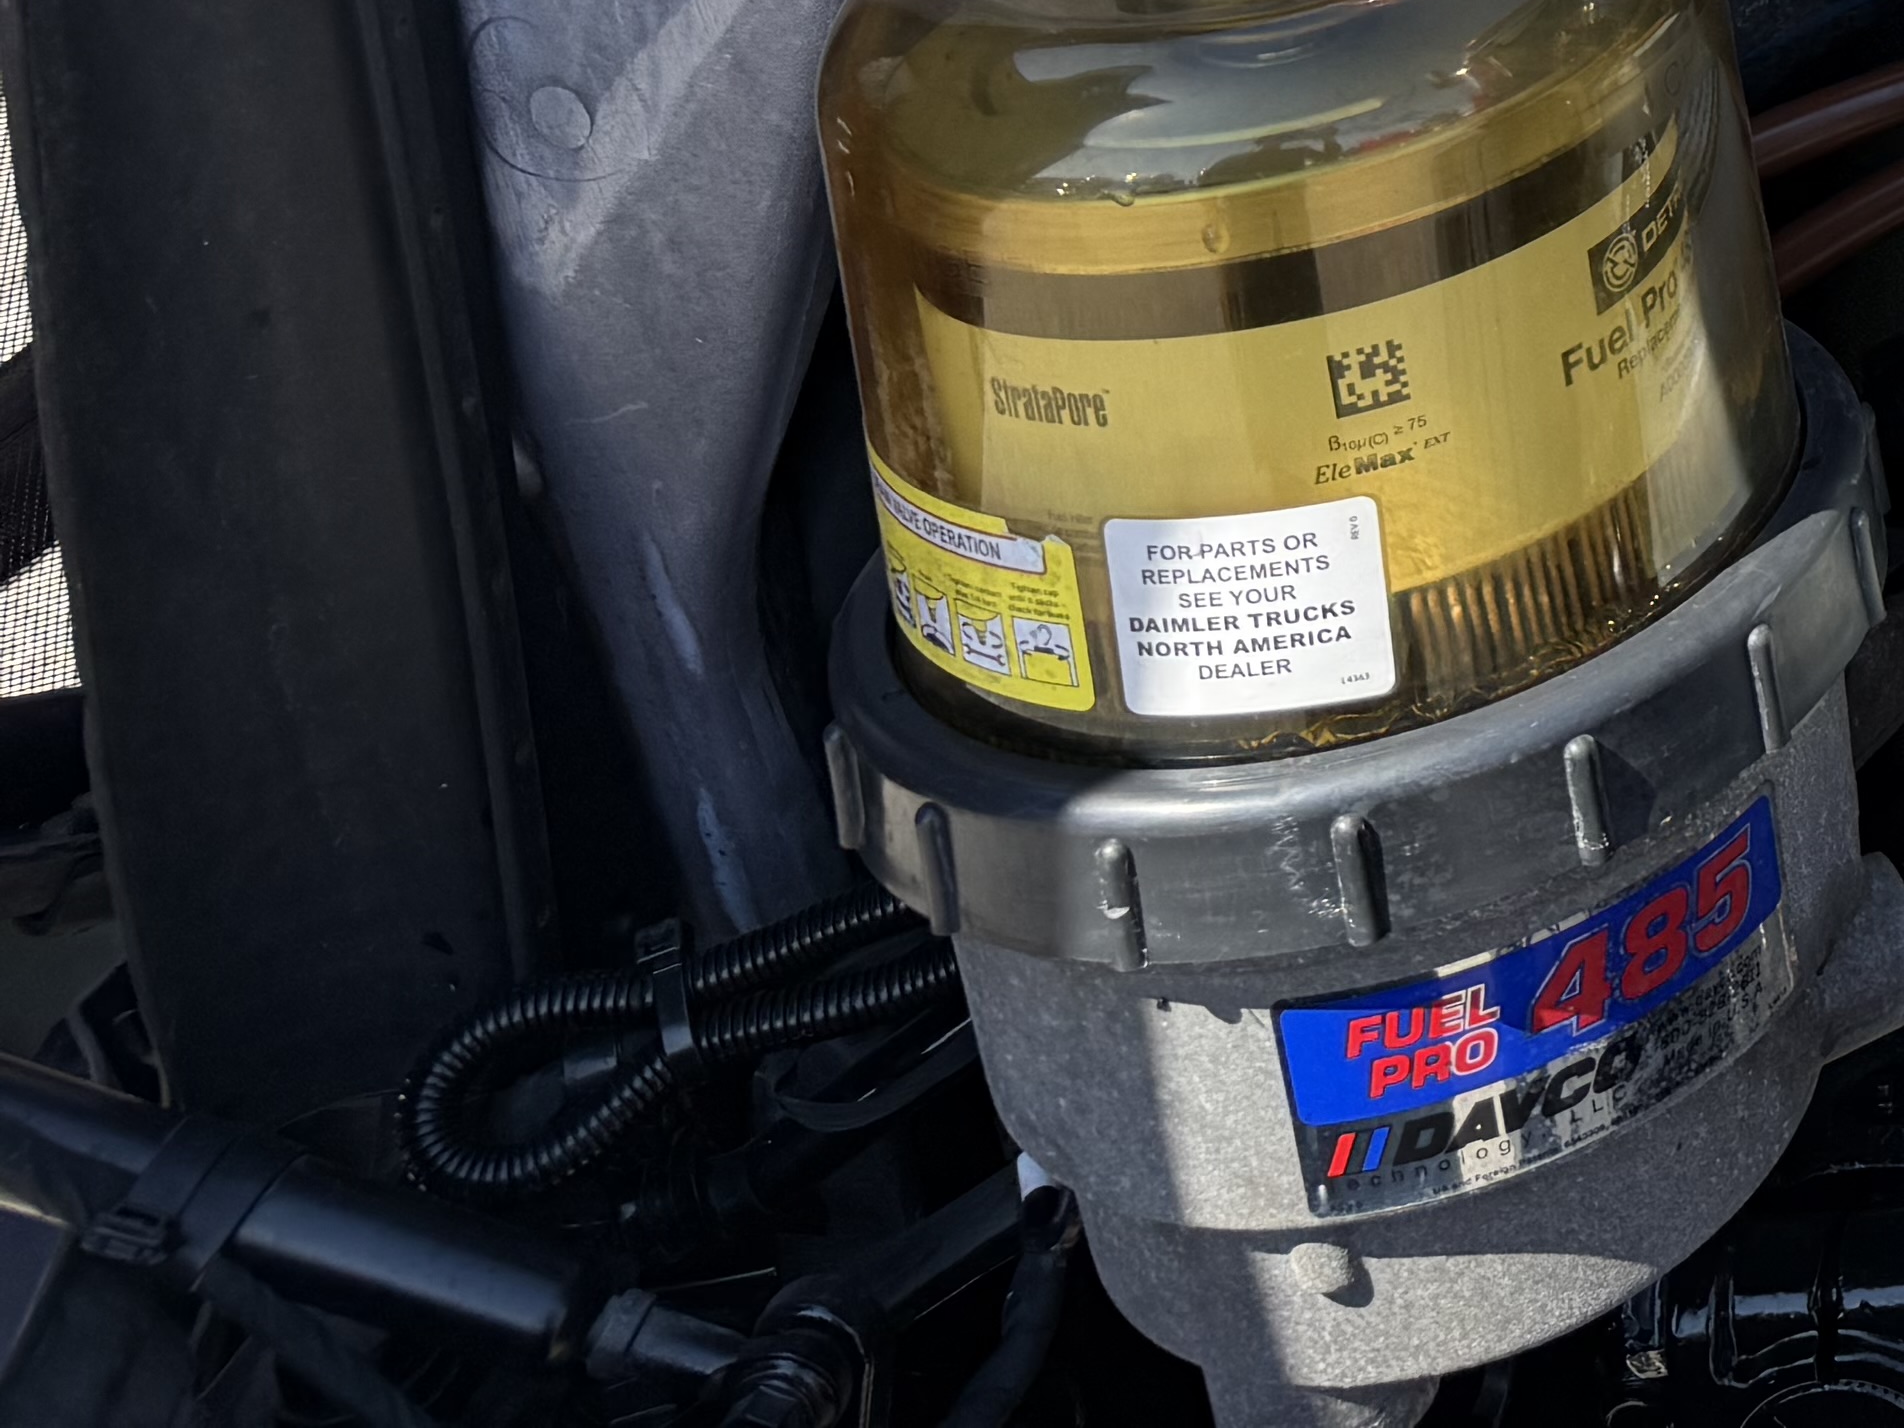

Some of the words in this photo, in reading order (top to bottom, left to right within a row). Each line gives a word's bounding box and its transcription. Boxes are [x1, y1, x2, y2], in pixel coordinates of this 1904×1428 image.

[1561, 324, 1634, 387] Fuel
[1640, 269, 1678, 329] Pro
[1407, 414, 1428, 431] 75
[1423, 431, 1451, 449] EXT
[922, 517, 1002, 561] OPERATION
[1147, 545, 1193, 561] FOR
[1200, 538, 1276, 559] PARTS
[1283, 532, 1318, 551] OR
[1141, 555, 1330, 585] REPLACEMENTS
[1178, 592, 1223, 609] SEE
[1230, 584, 1297, 606] YOUR
[1129, 615, 1241, 633] DAIMLER
[1247, 600, 1356, 629] TRUCKS
[1137, 640, 1223, 657] NORTH
[1233, 625, 1352, 655] AMERICA
[1198, 658, 1292, 680] DEALER
[1527, 824, 1752, 1038] 485
[1346, 982, 1500, 1060] FUEL
[1369, 1028, 1499, 1099] PRO
[1394, 1035, 1643, 1166] DAYCO
